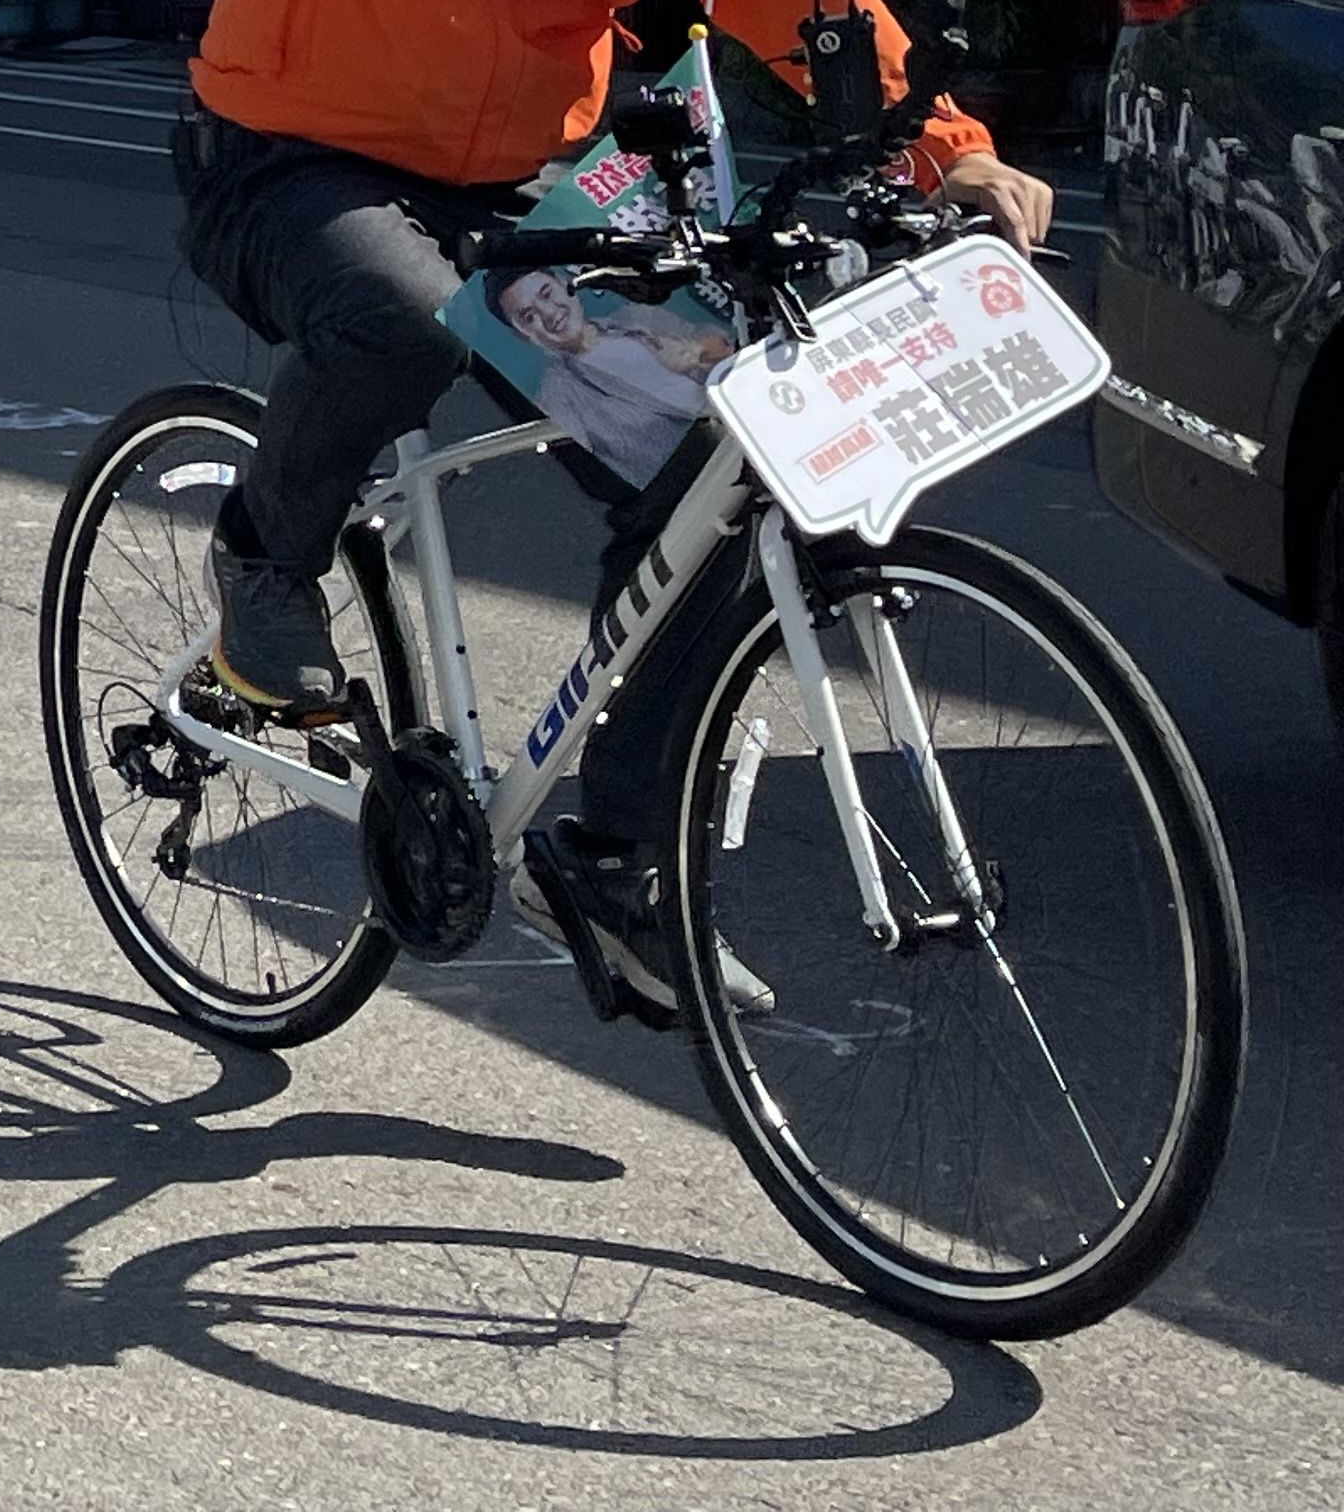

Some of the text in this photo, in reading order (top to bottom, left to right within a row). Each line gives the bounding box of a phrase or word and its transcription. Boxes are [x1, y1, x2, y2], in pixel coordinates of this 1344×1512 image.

[826, 322, 958, 404] 請唯一支持
[872, 330, 1070, 465] 莊瑞雄
